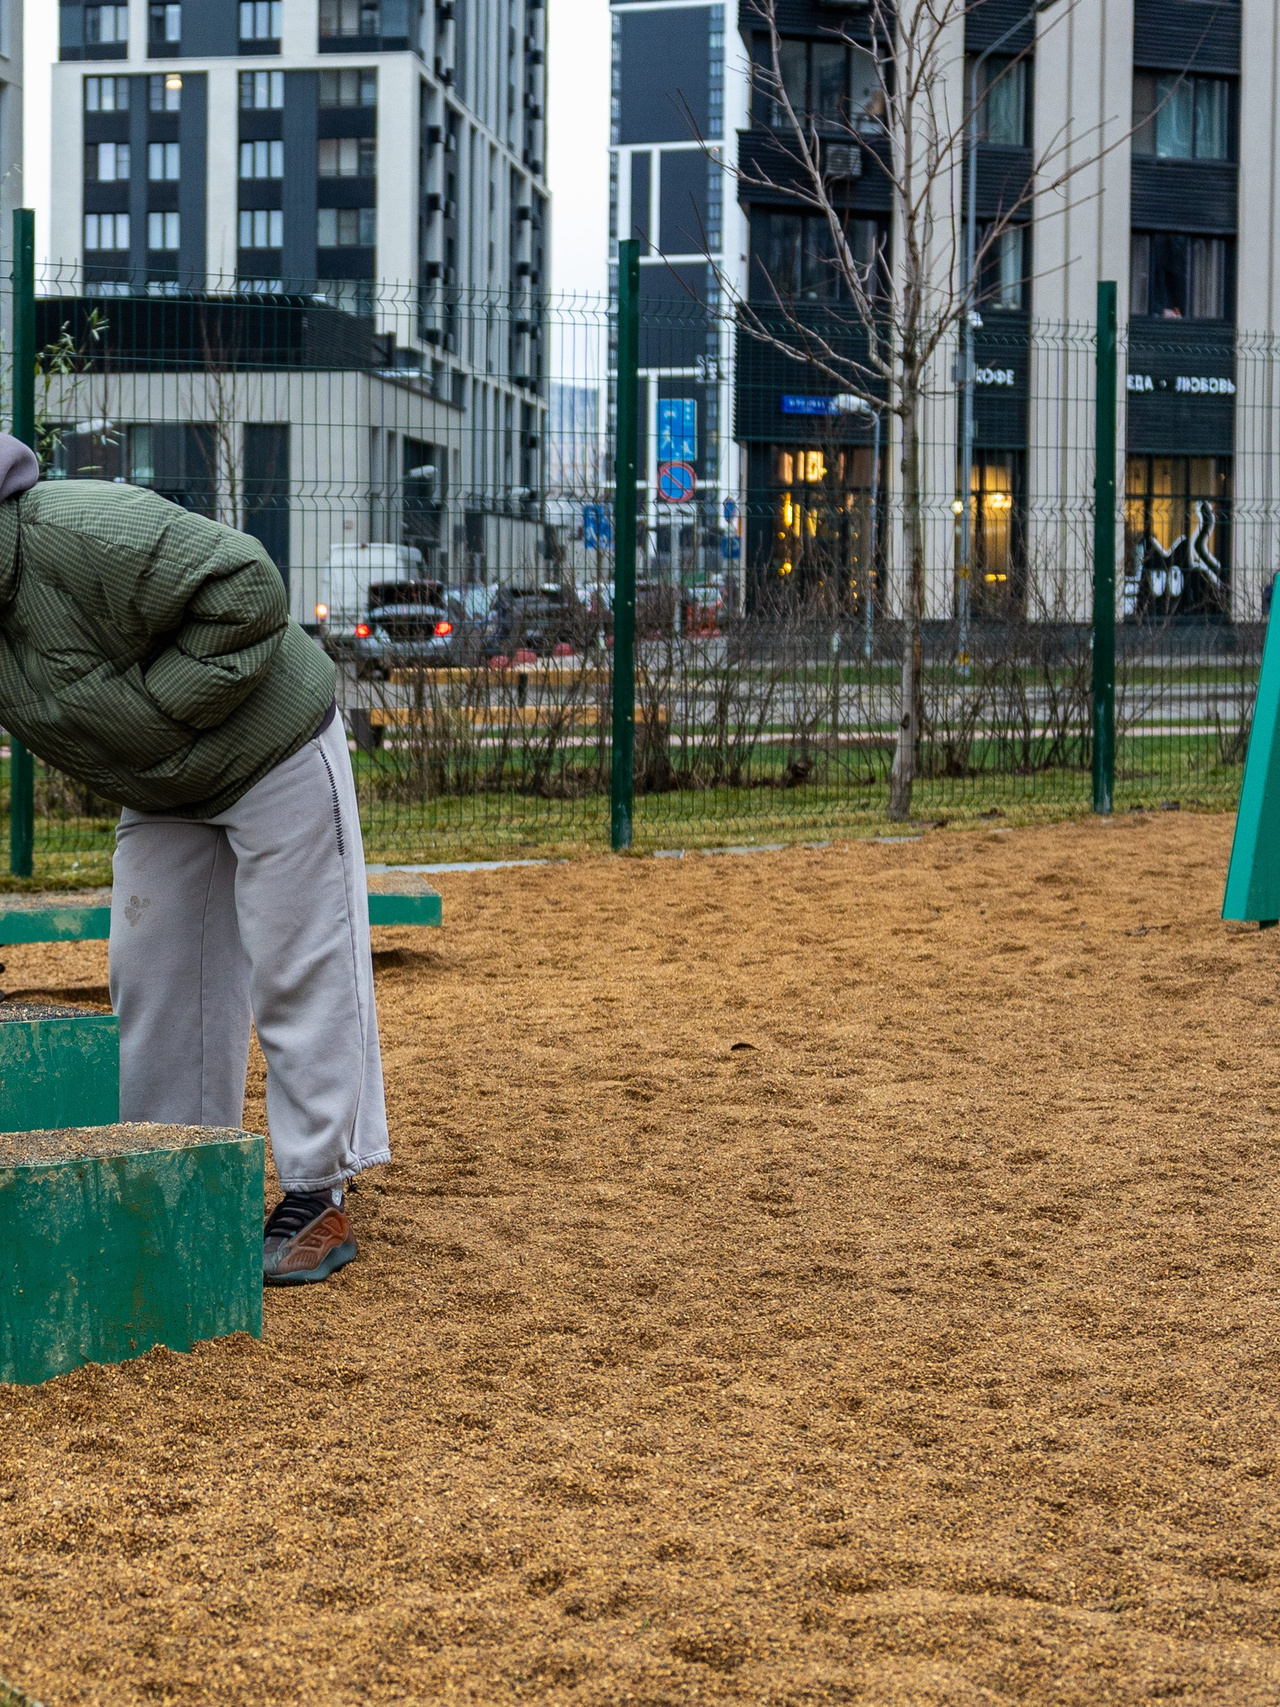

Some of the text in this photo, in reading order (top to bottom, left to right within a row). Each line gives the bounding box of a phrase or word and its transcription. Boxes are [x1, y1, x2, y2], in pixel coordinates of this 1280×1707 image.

[976, 368, 1015, 386] КОФЕ
[1126, 374, 1236, 394] ЕДА ЛЮБОВЬ
